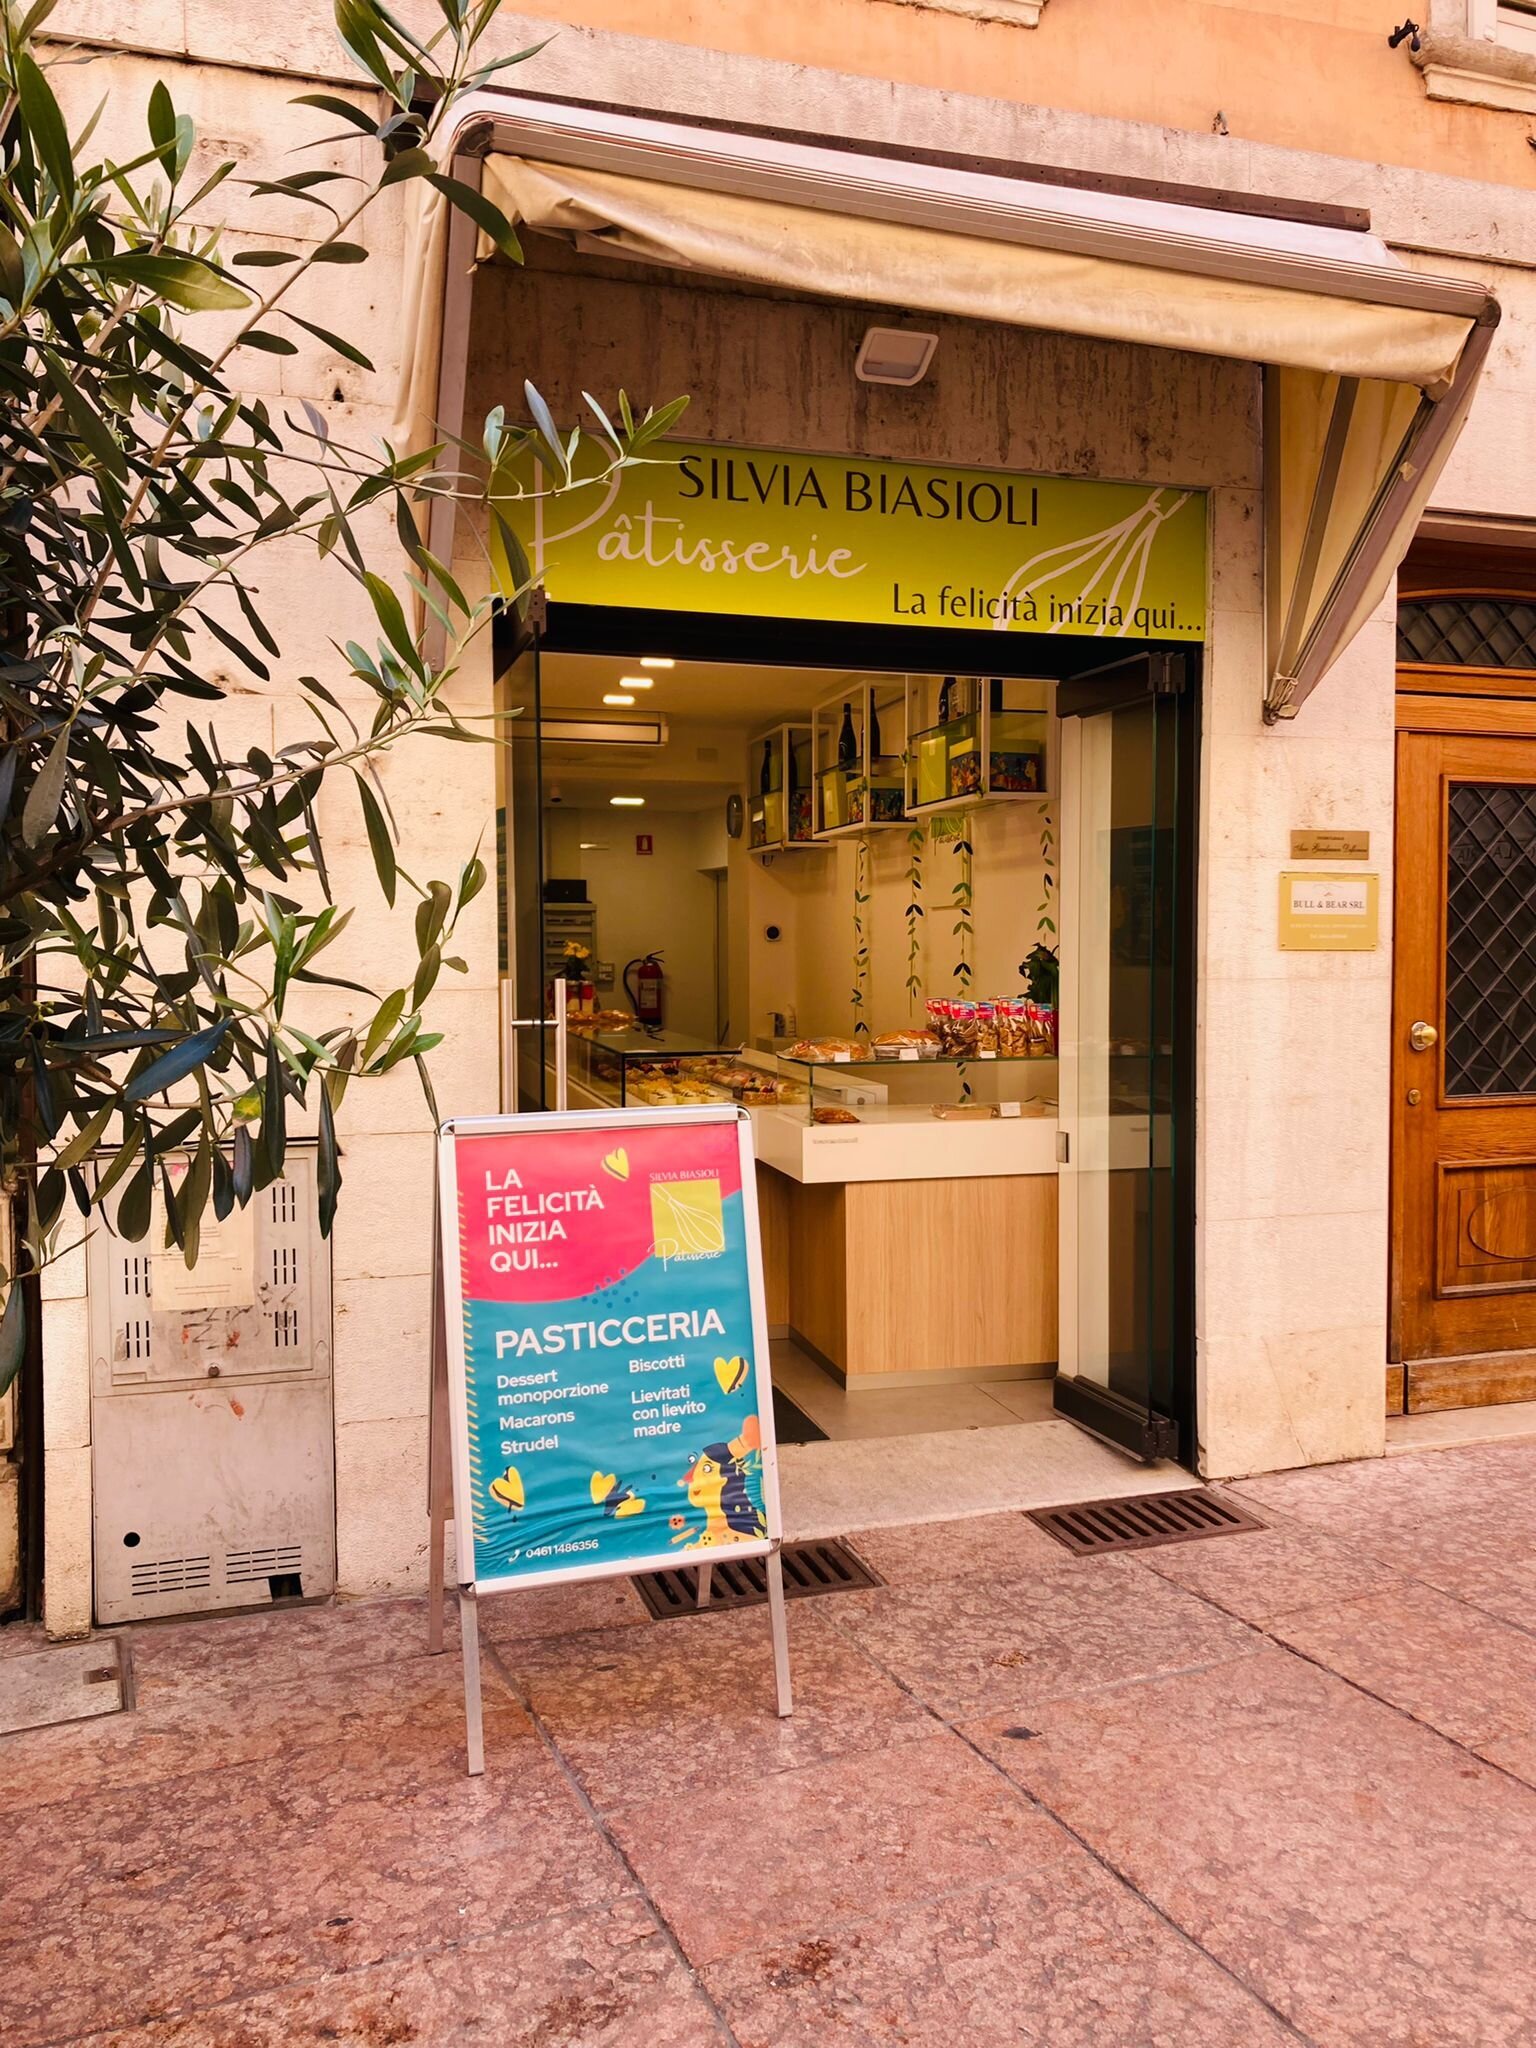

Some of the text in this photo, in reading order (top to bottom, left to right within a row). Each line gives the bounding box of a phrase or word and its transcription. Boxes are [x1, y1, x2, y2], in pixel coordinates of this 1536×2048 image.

[678, 455, 1039, 527] SILVIA BIASIOLI
[527, 432, 868, 590] Pâtisserie
[893, 583, 1202, 637] La felicità inizia qui...
[1293, 900, 1365, 909] BULL & BEAR SRL
[485, 1168, 523, 1191] LA
[649, 1168, 719, 1181] SILVIA BIASIOLI
[487, 1184, 604, 1218] FELICITÀ
[488, 1219, 567, 1245] INIZIA
[489, 1248, 559, 1272] QUI...
[495, 1308, 726, 1359] PASTICCERIA
[629, 1354, 686, 1373] Biscotti
[497, 1369, 559, 1389] Dessert
[497, 1382, 609, 1406] monoporzione
[631, 1384, 691, 1404] Lievitati
[499, 1410, 576, 1431] Macarons
[632, 1401, 706, 1421] con lievito
[633, 1421, 682, 1438] madre
[501, 1435, 559, 1455] Strudel
[526, 1539, 599, 1559] 04611486356
